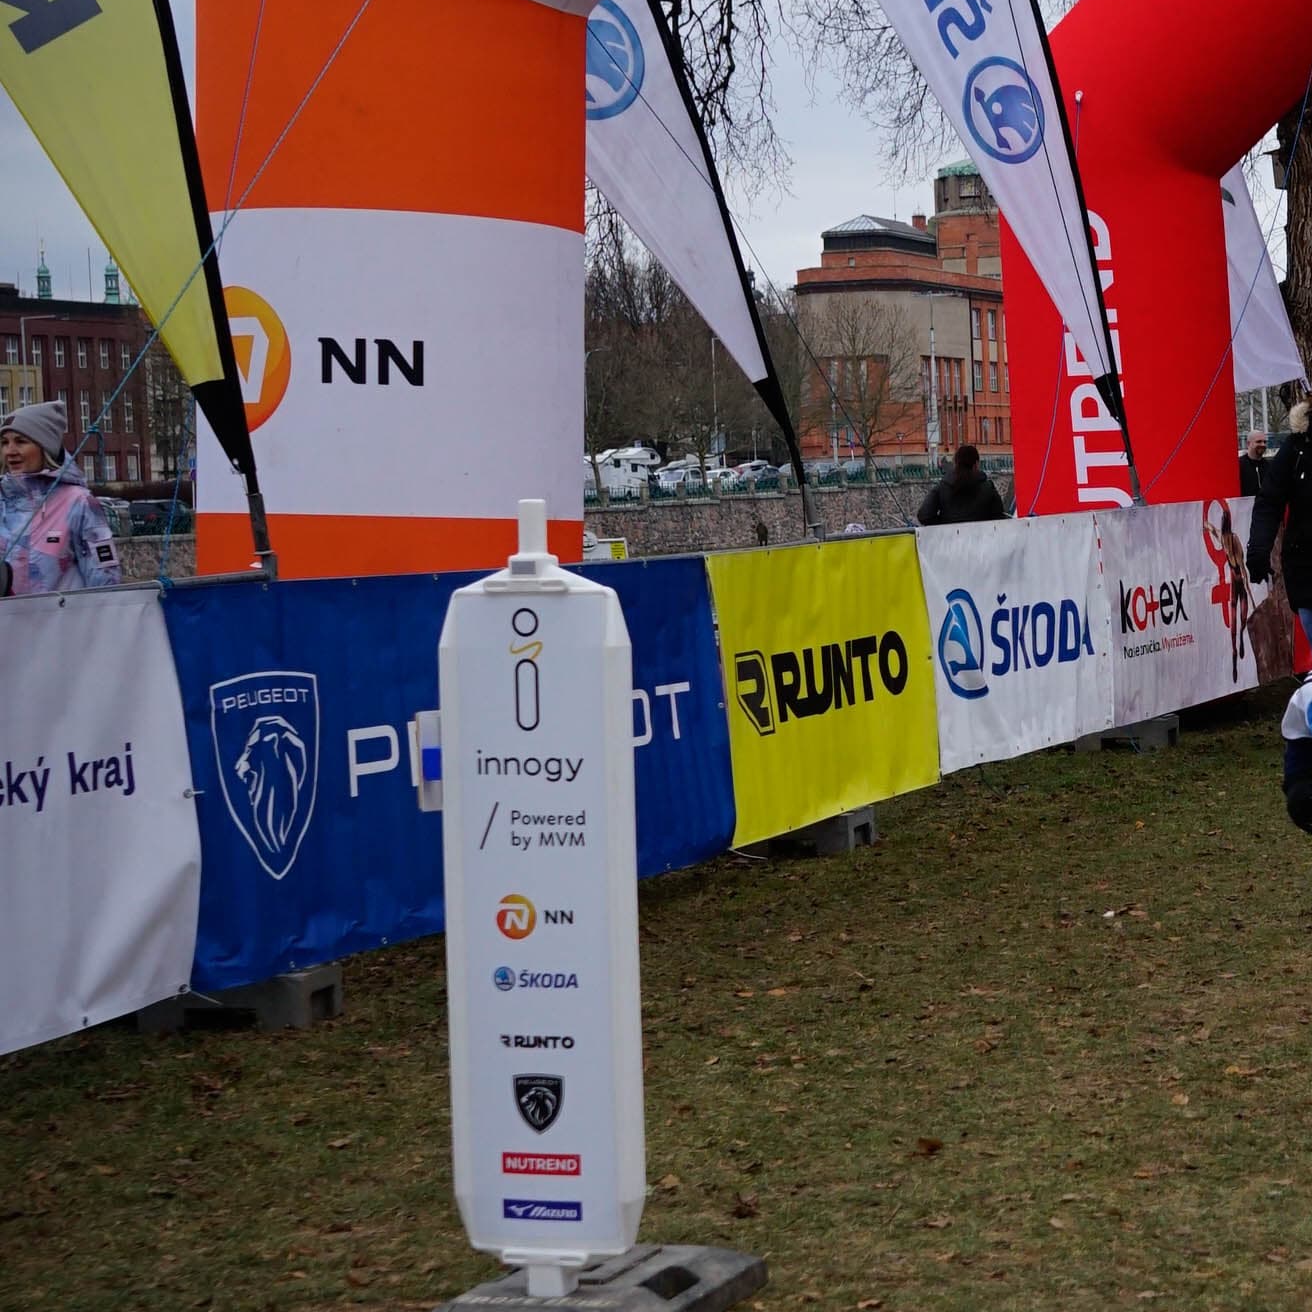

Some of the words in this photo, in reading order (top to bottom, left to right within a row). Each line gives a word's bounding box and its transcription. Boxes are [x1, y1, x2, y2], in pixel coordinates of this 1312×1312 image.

[318, 337, 425, 387] NN
[1119, 579, 1188, 633] kotex
[991, 595, 1094, 676] ŠKODA
[772, 630, 909, 722] RUNTO
[222, 687, 310, 714] PEUGEOT
[67, 742, 136, 796] kraj
[476, 749, 585, 782] innogy
[510, 809, 586, 828] Powered
[510, 831, 532, 851] by
[538, 832, 586, 848] MVM
[544, 909, 574, 925] NN
[519, 969, 579, 989] ŠKODA
[514, 1036, 575, 1049] RUNTO
[505, 1157, 578, 1172] NUTREND
